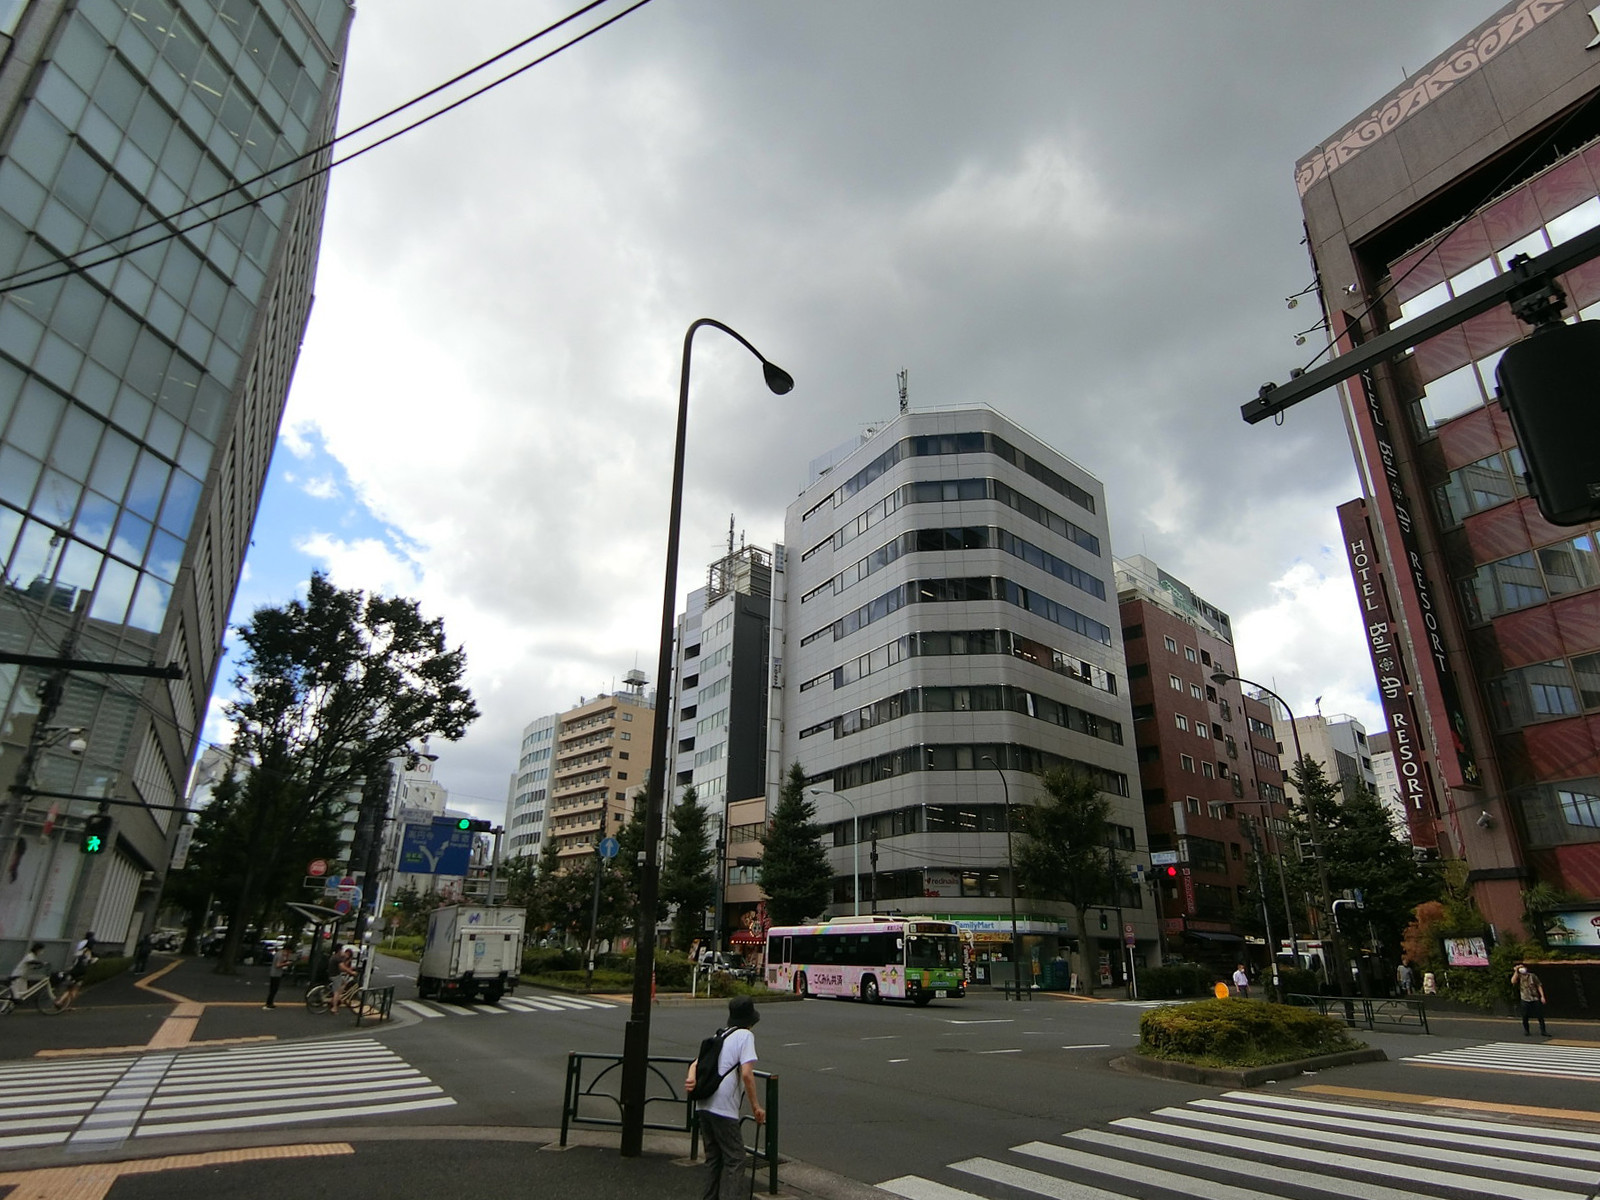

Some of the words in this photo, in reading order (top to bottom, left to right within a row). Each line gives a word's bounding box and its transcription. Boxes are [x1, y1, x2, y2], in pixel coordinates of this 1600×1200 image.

[1409, 550, 1446, 672] RESORT
[1350, 539, 1379, 611] HOTEL
[1369, 622, 1392, 655] Bali
[1381, 675, 1402, 699] An
[1392, 713, 1424, 810] RESORT
[955, 921, 995, 931] FamilyMart
[814, 973, 843, 986] こくみん共済
